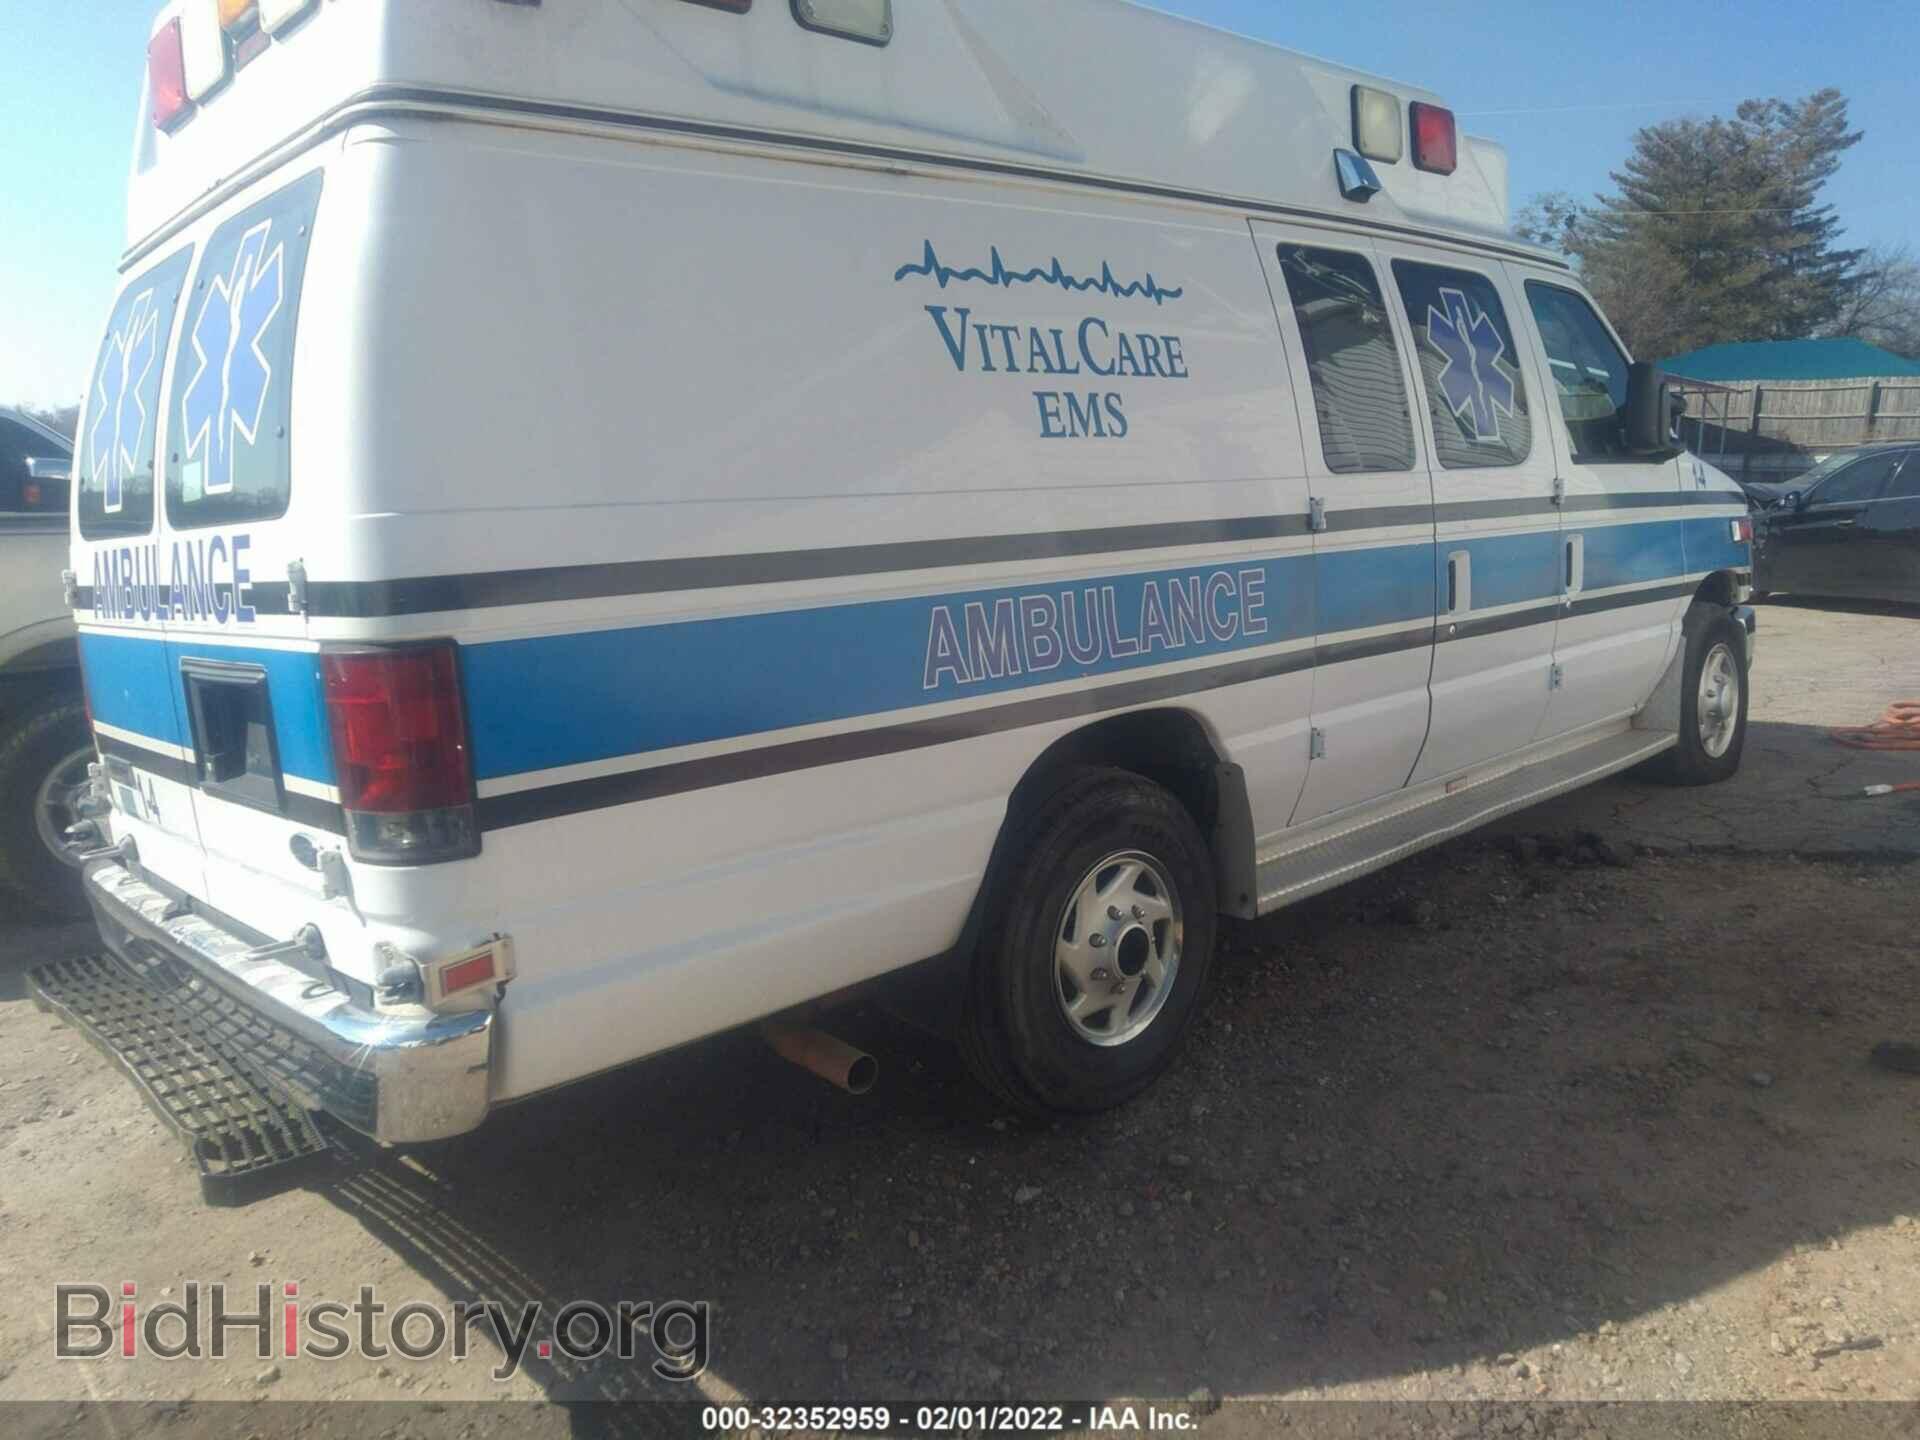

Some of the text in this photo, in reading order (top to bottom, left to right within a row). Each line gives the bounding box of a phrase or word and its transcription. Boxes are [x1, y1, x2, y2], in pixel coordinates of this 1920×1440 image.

[1032, 391, 1128, 438] EMS
[94, 534, 257, 624] AMBULANCE
[923, 568, 1268, 690] AMBULANCE
